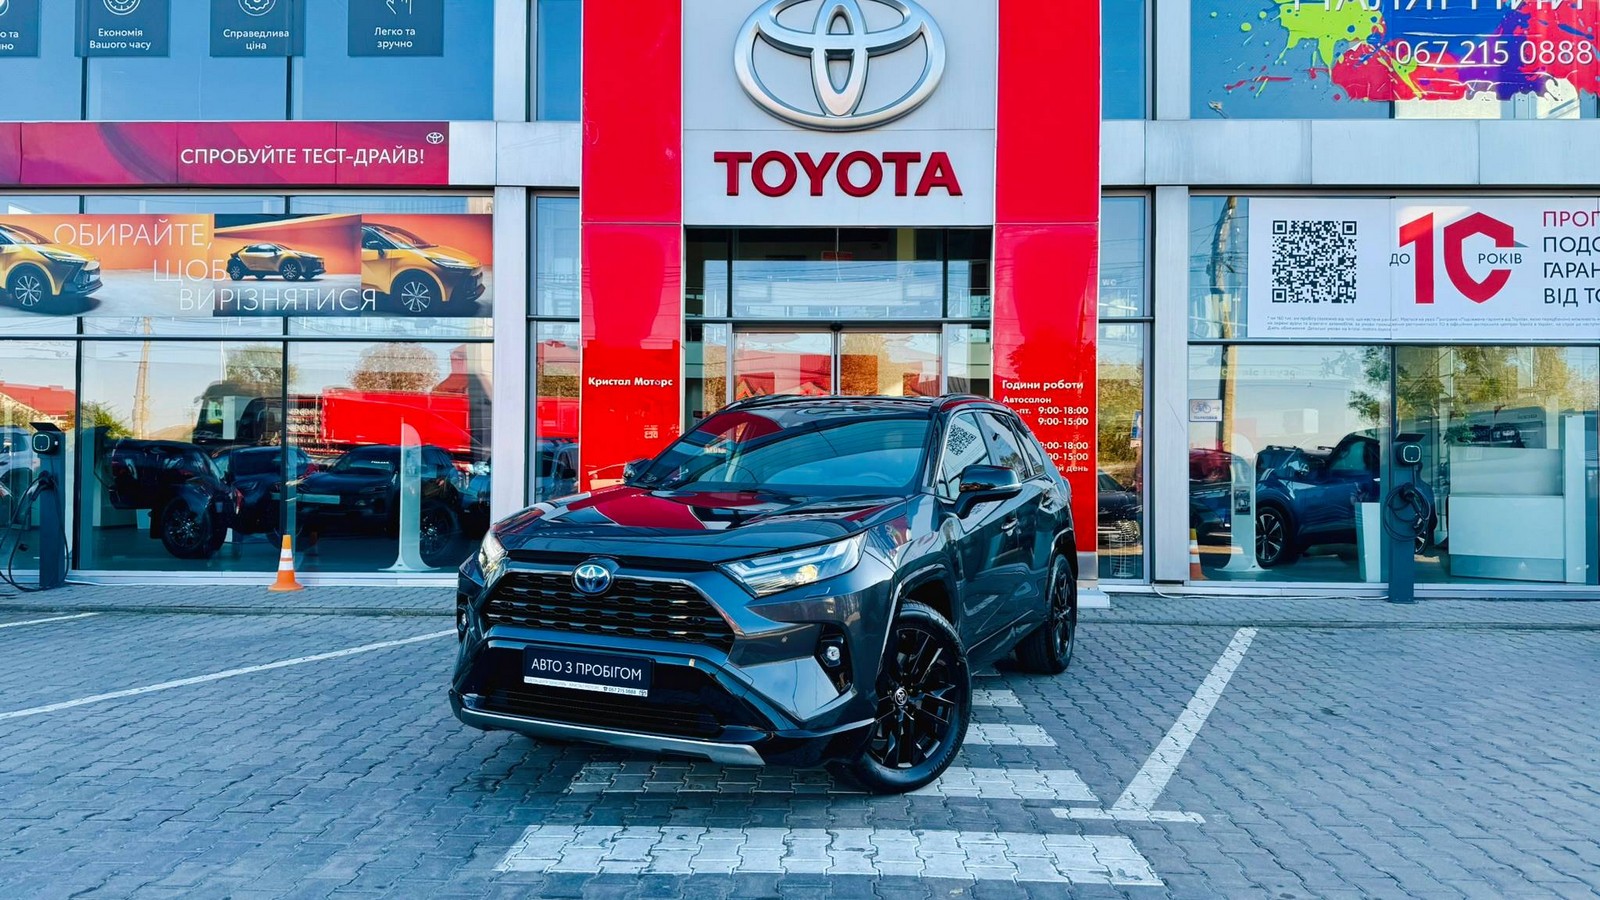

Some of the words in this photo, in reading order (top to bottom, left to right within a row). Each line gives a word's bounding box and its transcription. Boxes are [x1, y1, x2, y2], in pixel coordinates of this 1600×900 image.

[98, 28, 143, 37] Економія
[223, 29, 290, 38] Справедлива
[374, 27, 403, 36] Легко
[405, 28, 416, 36] та
[89, 40, 127, 49] Вашого
[129, 42, 151, 50] часу
[246, 42, 267, 50] ціна
[377, 40, 413, 49] зручно
[1395, 40, 1448, 65] 067
[1460, 40, 1508, 65] 215
[1519, 40, 1594, 65] 0888
[180, 145, 297, 164] СПРОБУЙТЕ
[302, 145, 425, 167] ТЕСТ-ДРАЙВ!
[714, 150, 963, 198] TOYOTA
[54, 219, 212, 249] ОБИРАЙТЕ,
[1389, 253, 1411, 267] ДО
[1398, 211, 1515, 304] 10
[1478, 253, 1523, 265] РОКІВ
[153, 259, 227, 284] ЩОБ
[180, 288, 376, 311] ВИРІЗНЯТИСЯ
[1544, 288, 1578, 307] ВІД
[588, 377, 631, 387] Кристал
[634, 377, 673, 388] Моторс
[1002, 380, 1041, 390] Години
[1043, 380, 1084, 391] роботи
[1003, 396, 1052, 404] Автосалон
[1038, 406, 1089, 415] 9:00-18:00
[1038, 417, 1089, 426] 9:00-15:00
[531, 658, 563, 672] АВТО
[565, 661, 573, 674] З
[575, 662, 642, 681] ПРОБІГОМ
